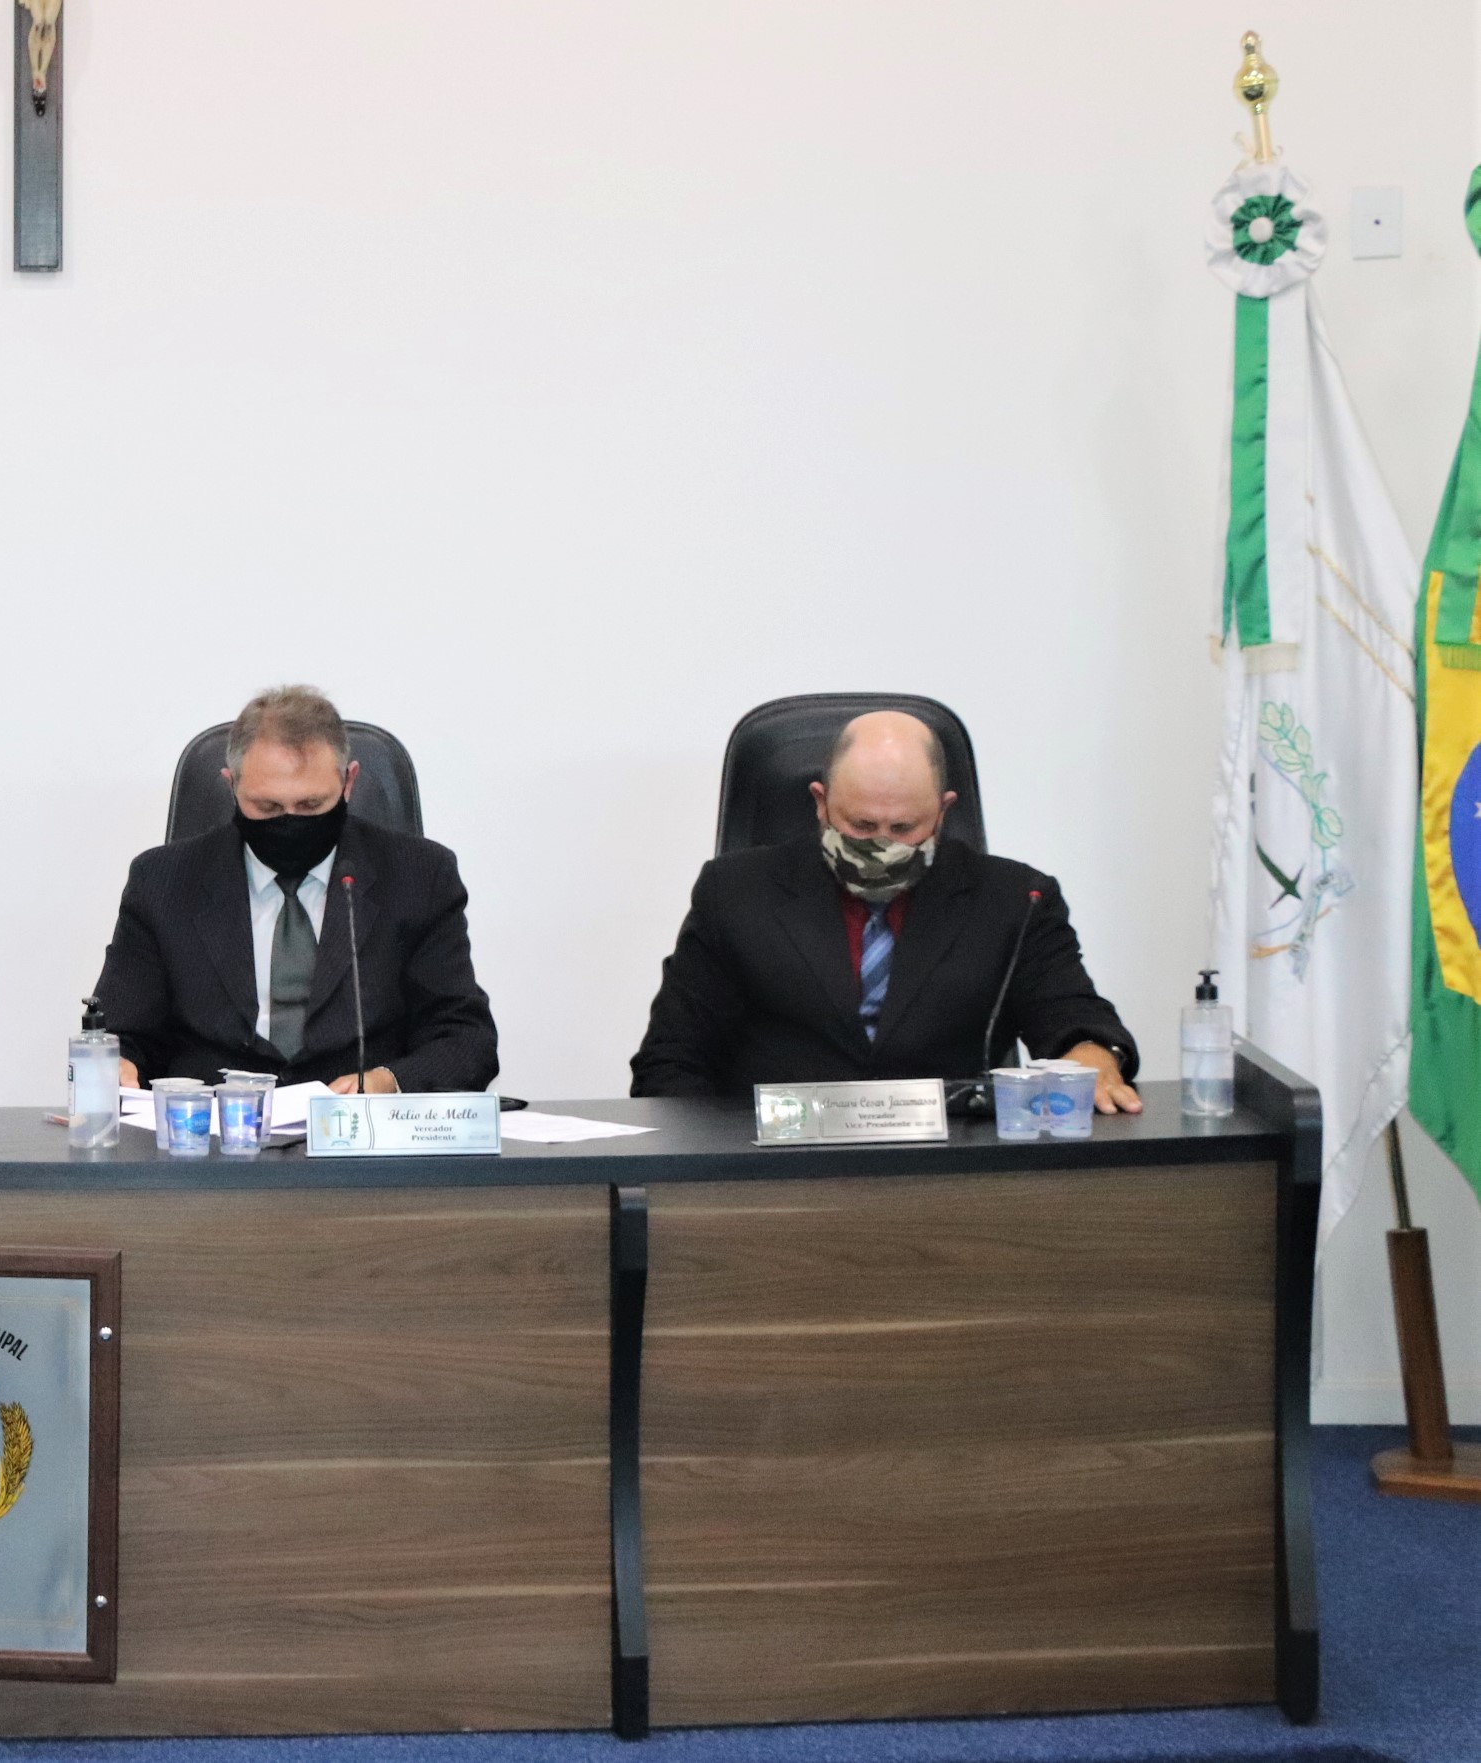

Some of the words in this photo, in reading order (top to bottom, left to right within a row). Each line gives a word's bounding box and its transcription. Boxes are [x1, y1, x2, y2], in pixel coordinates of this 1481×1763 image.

[424, 1108, 438, 1120] de
[441, 1108, 478, 1120] Mello
[411, 1134, 457, 1142] Presidente
